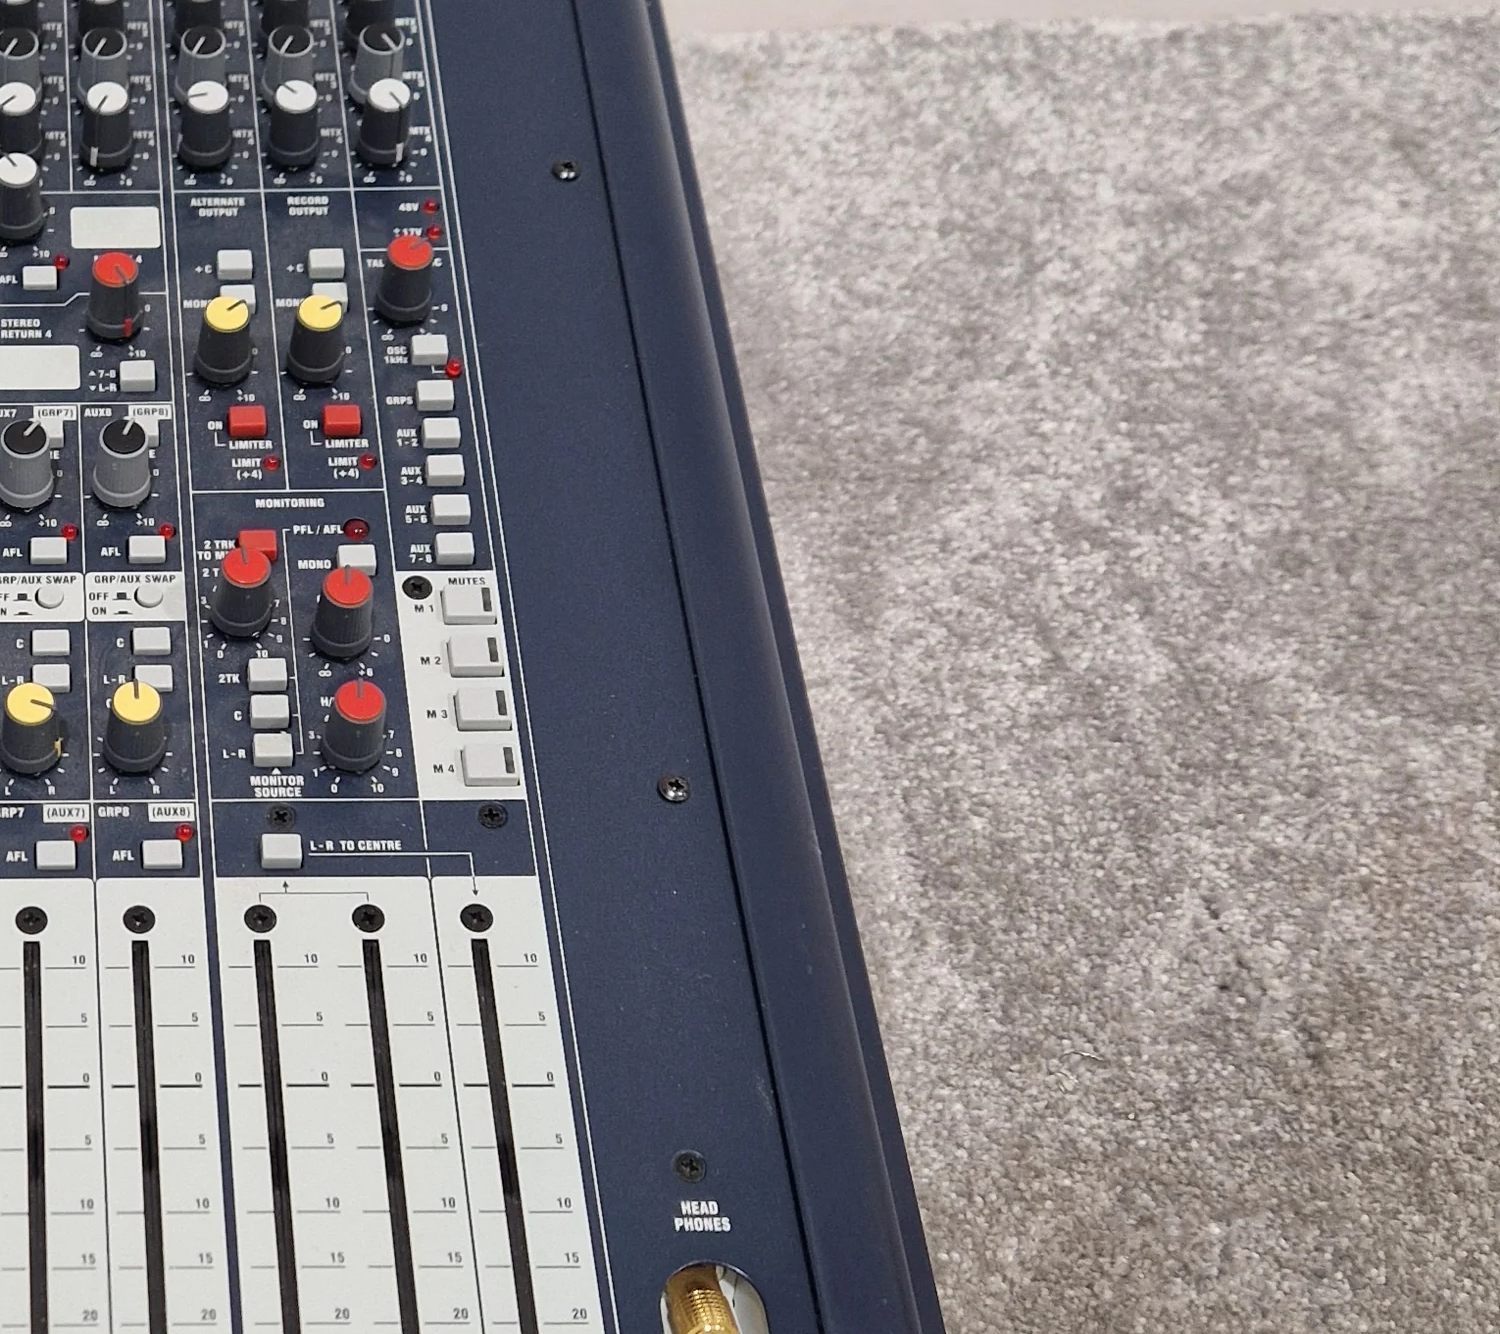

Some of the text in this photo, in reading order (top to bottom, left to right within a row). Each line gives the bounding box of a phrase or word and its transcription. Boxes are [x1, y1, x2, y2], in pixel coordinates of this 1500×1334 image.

[191, 197, 245, 207] ALTERNATE
[287, 196, 329, 206] RECORD
[199, 208, 238, 217] OUTPUT
[288, 206, 329, 216] OUTPUT
[399, 203, 419, 212] 48V
[0, 318, 40, 328] STEREO
[0, 329, 52, 339] RETURN 4
[387, 346, 407, 355] OSC
[384, 355, 409, 364] 1kHz
[98, 383, 116, 392] L-R
[386, 396, 413, 405] GRPS
[38, 408, 74, 419] (GRP7)
[84, 406, 169, 418] AUX8 (GRP8)
[208, 421, 223, 430] ON
[397, 429, 417, 438] AUX
[229, 440, 272, 449] LIMITER
[232, 458, 261, 468] LIMIT
[236, 470, 263, 481] (+4)
[401, 467, 421, 476] AUX
[255, 498, 325, 508] MONITORING
[405, 505, 426, 514] AUX
[293, 524, 344, 535] PFL AFL
[204, 540, 236, 549] 2 TRK
[411, 545, 431, 553] AUX
[298, 560, 331, 570] MONO
[448, 577, 486, 585] MUTES
[415, 604, 434, 613] M 1
[421, 657, 441, 665] M 2
[219, 674, 240, 683] 2TK
[234, 711, 242, 721] C
[427, 709, 448, 718] M 3
[223, 749, 246, 759] L-R
[434, 764, 454, 773] M 4
[250, 776, 305, 787] MONITOR
[254, 787, 302, 798] SOURCE
[47, 807, 86, 819] (AUX7)
[98, 805, 191, 818] GRP8 (AUX8)
[310, 840, 402, 851] L-R TO CENTRE
[523, 953, 538, 963] 10
[539, 1012, 545, 1022] 5
[546, 1072, 554, 1082] 0
[555, 1134, 562, 1144] 5
[557, 1198, 571, 1208] 10
[681, 1201, 718, 1215] HEAD
[675, 1217, 730, 1231] PHONES
[564, 1253, 579, 1263] 15
[572, 1309, 588, 1320] 20
